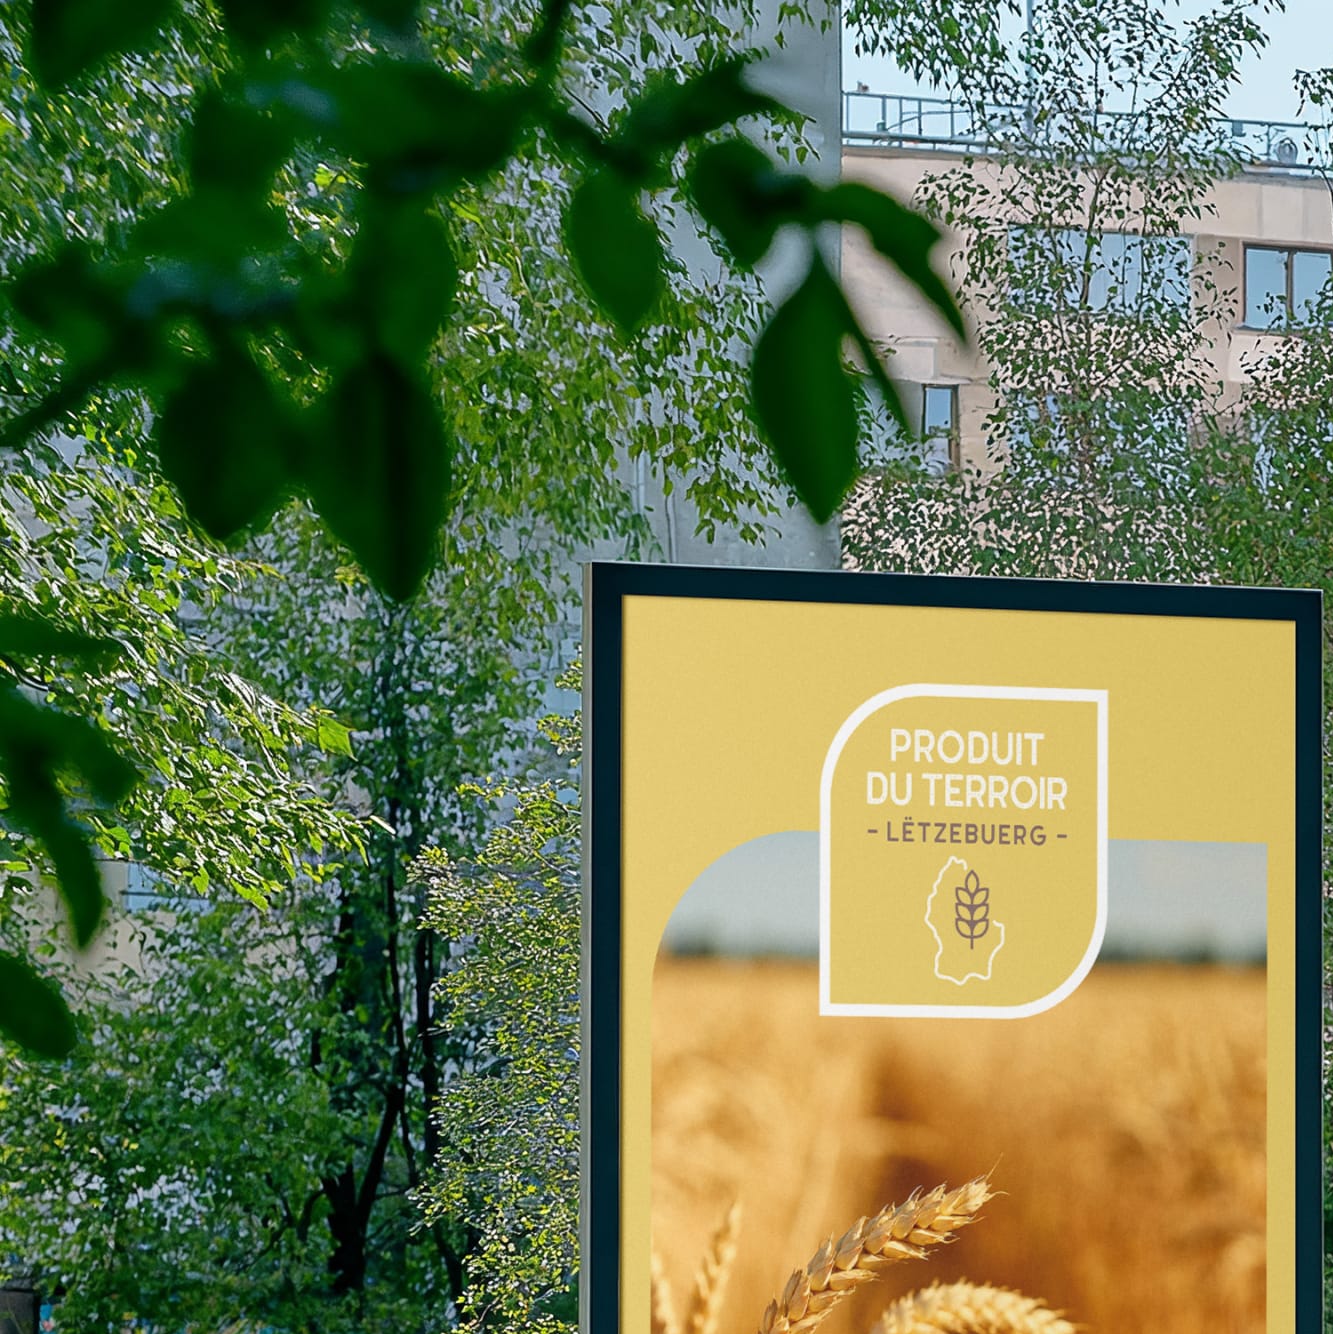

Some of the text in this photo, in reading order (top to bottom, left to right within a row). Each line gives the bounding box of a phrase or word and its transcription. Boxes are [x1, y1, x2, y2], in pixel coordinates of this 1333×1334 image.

[890, 727, 1045, 766] PRODUIT
[866, 771, 1068, 811] DU TERROIR
[886, 816, 1047, 847] LËTZEBUERG
